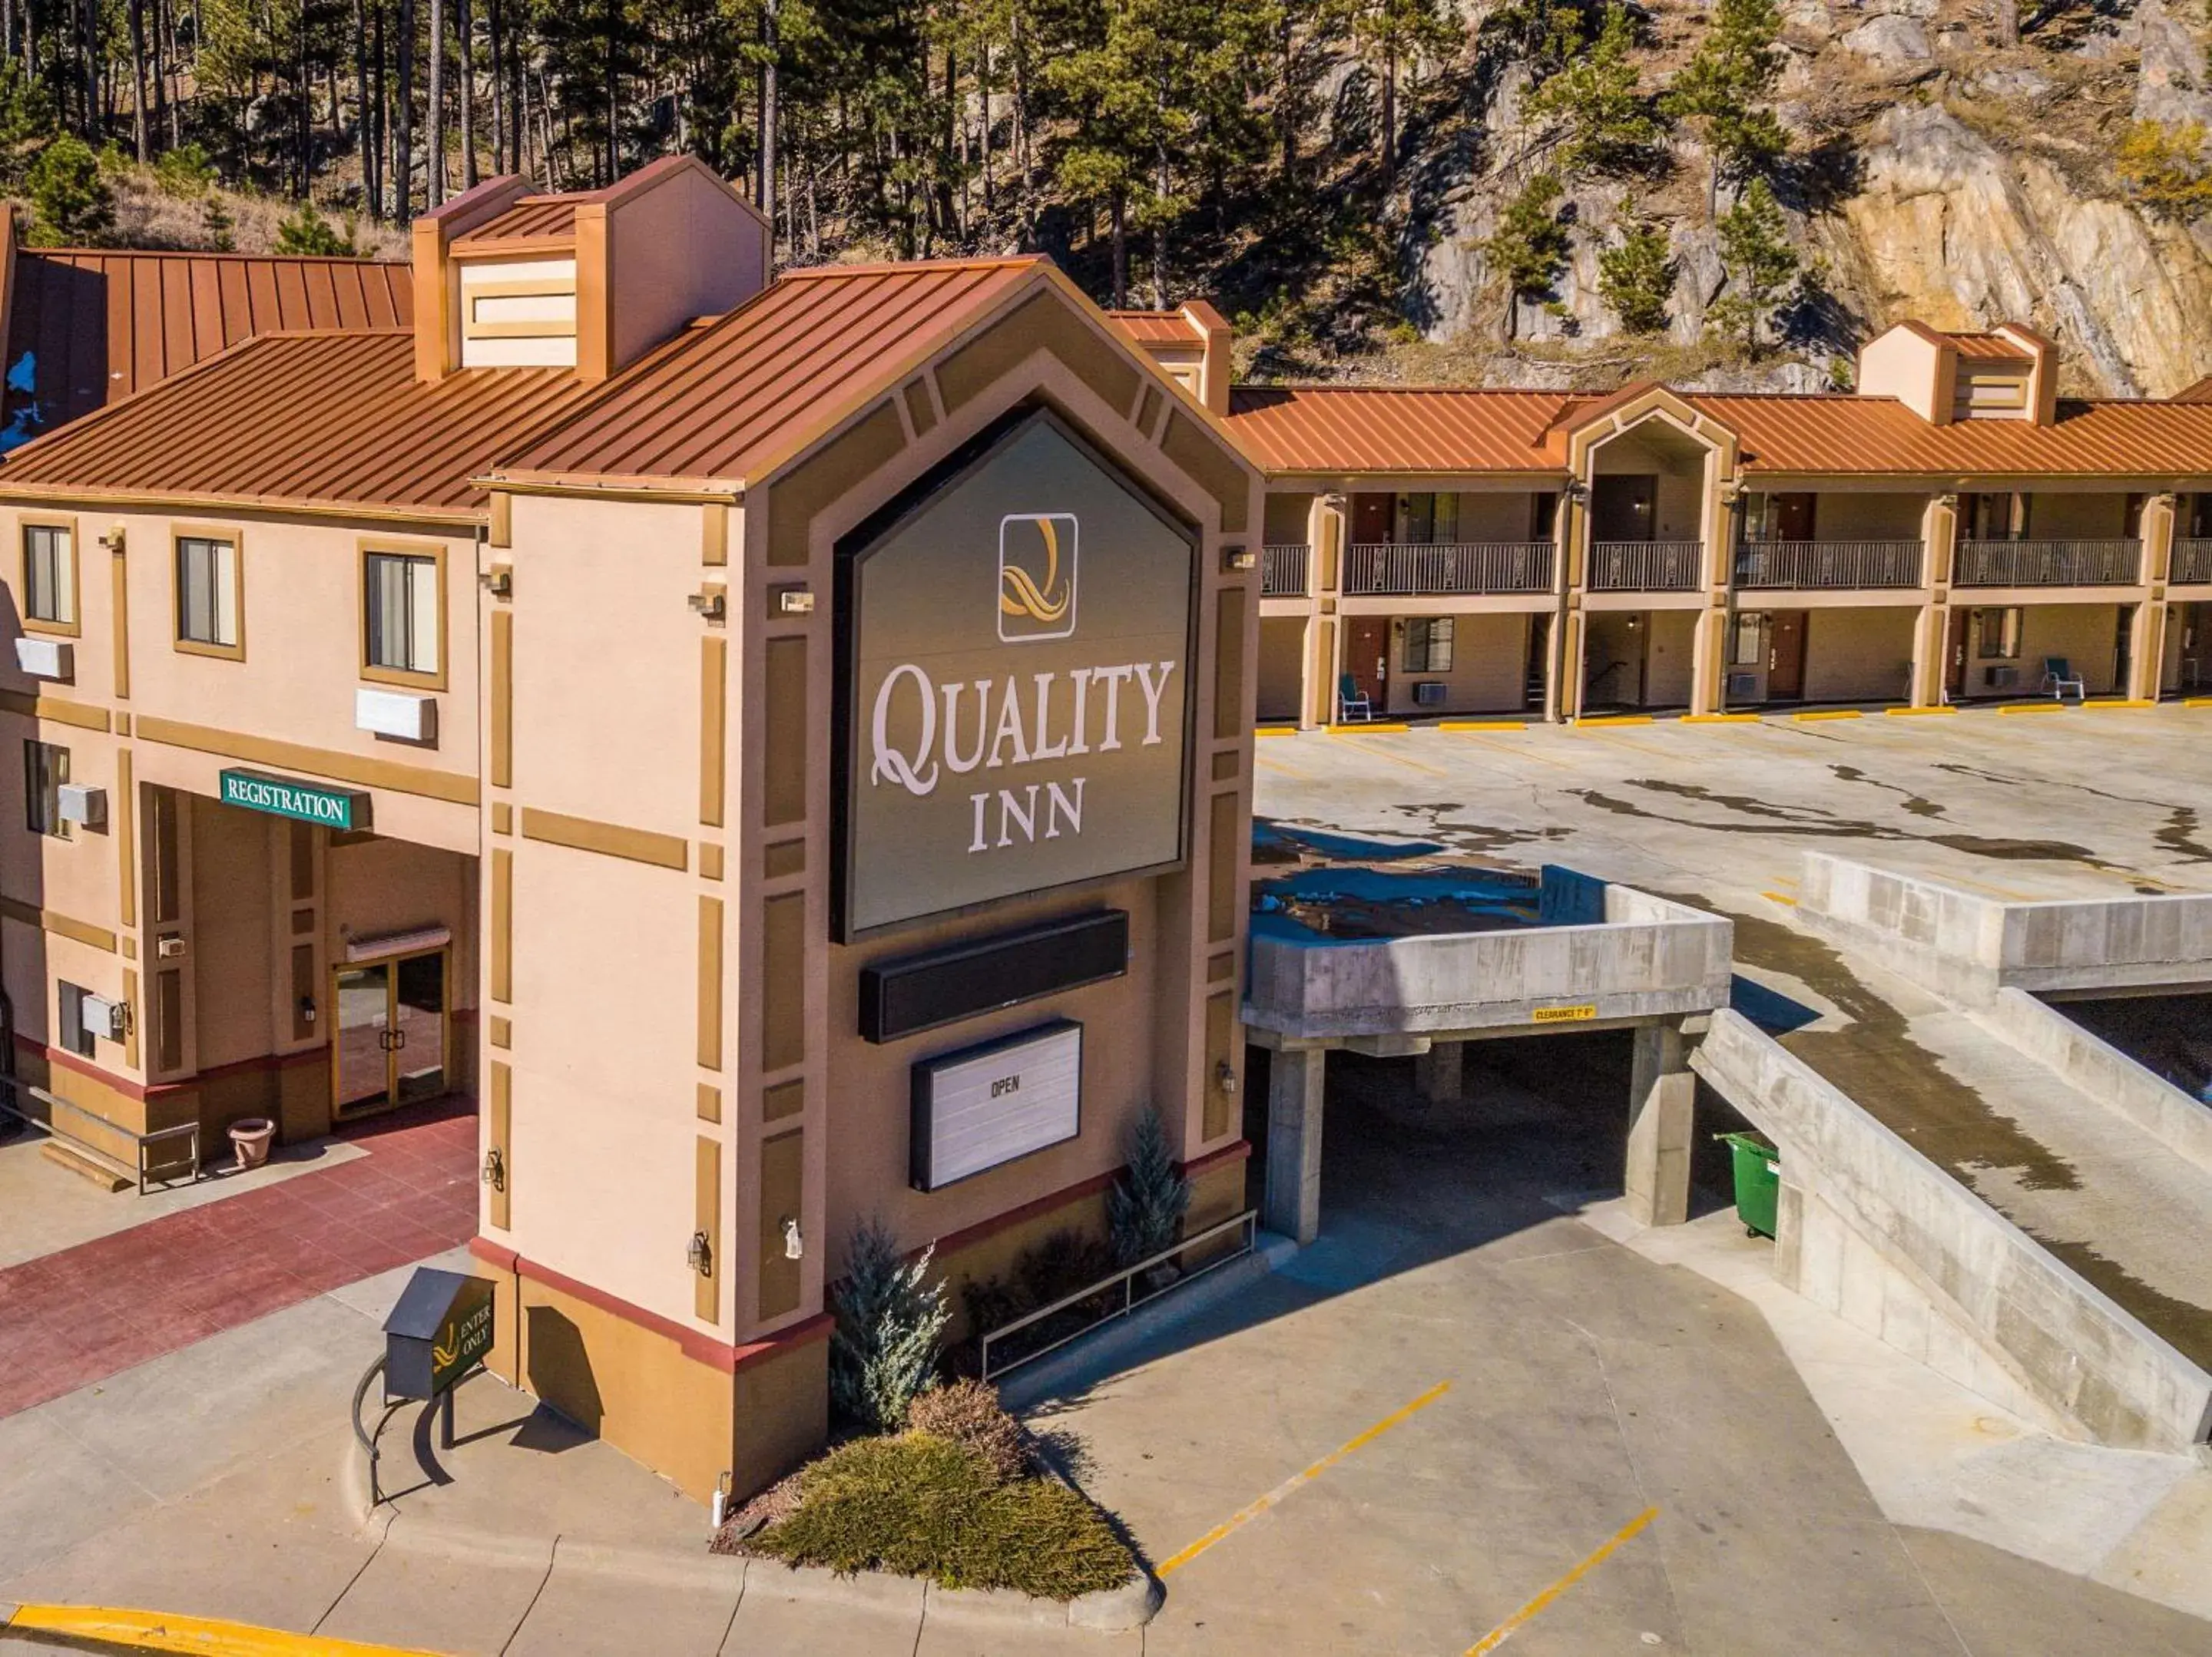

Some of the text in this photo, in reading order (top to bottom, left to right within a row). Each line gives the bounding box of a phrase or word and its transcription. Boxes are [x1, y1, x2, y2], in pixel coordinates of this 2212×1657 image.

[871, 660, 1176, 796] QUALITY
[227, 778, 344, 822] REGISTRATION
[968, 777, 1087, 853] INN
[1535, 1009, 1575, 1020] CLEARANCE
[991, 1074, 1020, 1098] OPEN
[461, 1305, 491, 1339] ENTER
[463, 1324, 488, 1355] ONLY
